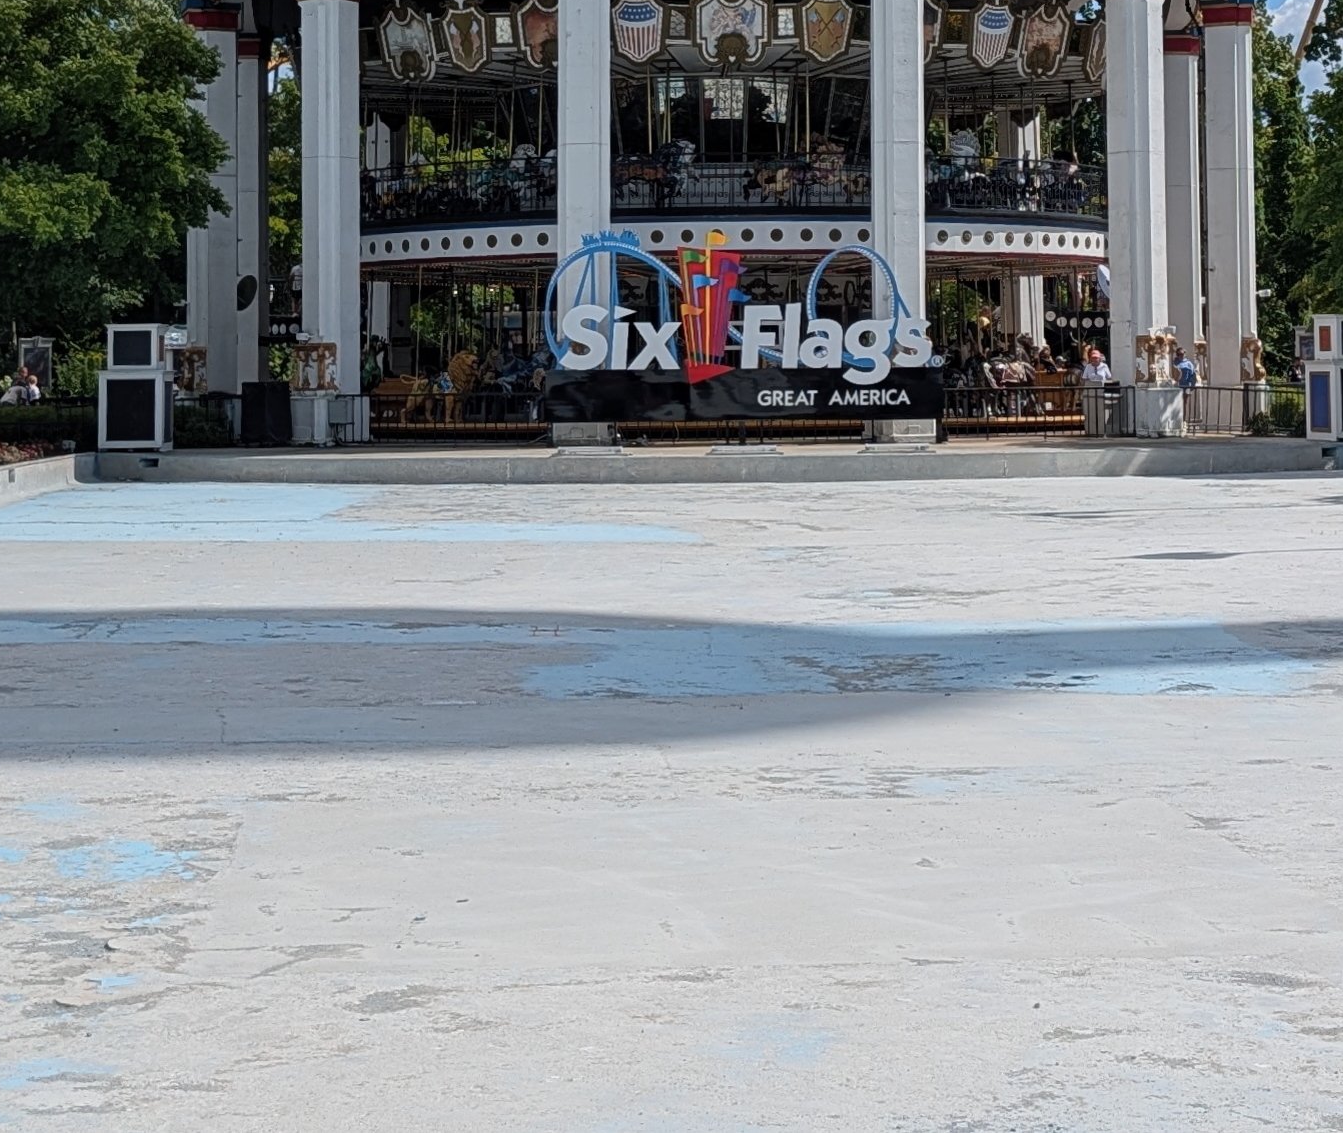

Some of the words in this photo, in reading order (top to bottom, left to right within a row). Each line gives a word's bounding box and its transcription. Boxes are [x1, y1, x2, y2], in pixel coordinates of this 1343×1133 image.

[559, 305, 681, 370] Six
[742, 303, 933, 384] Flags
[757, 389, 818, 407] GREAT
[829, 388, 911, 406] AMERICA
